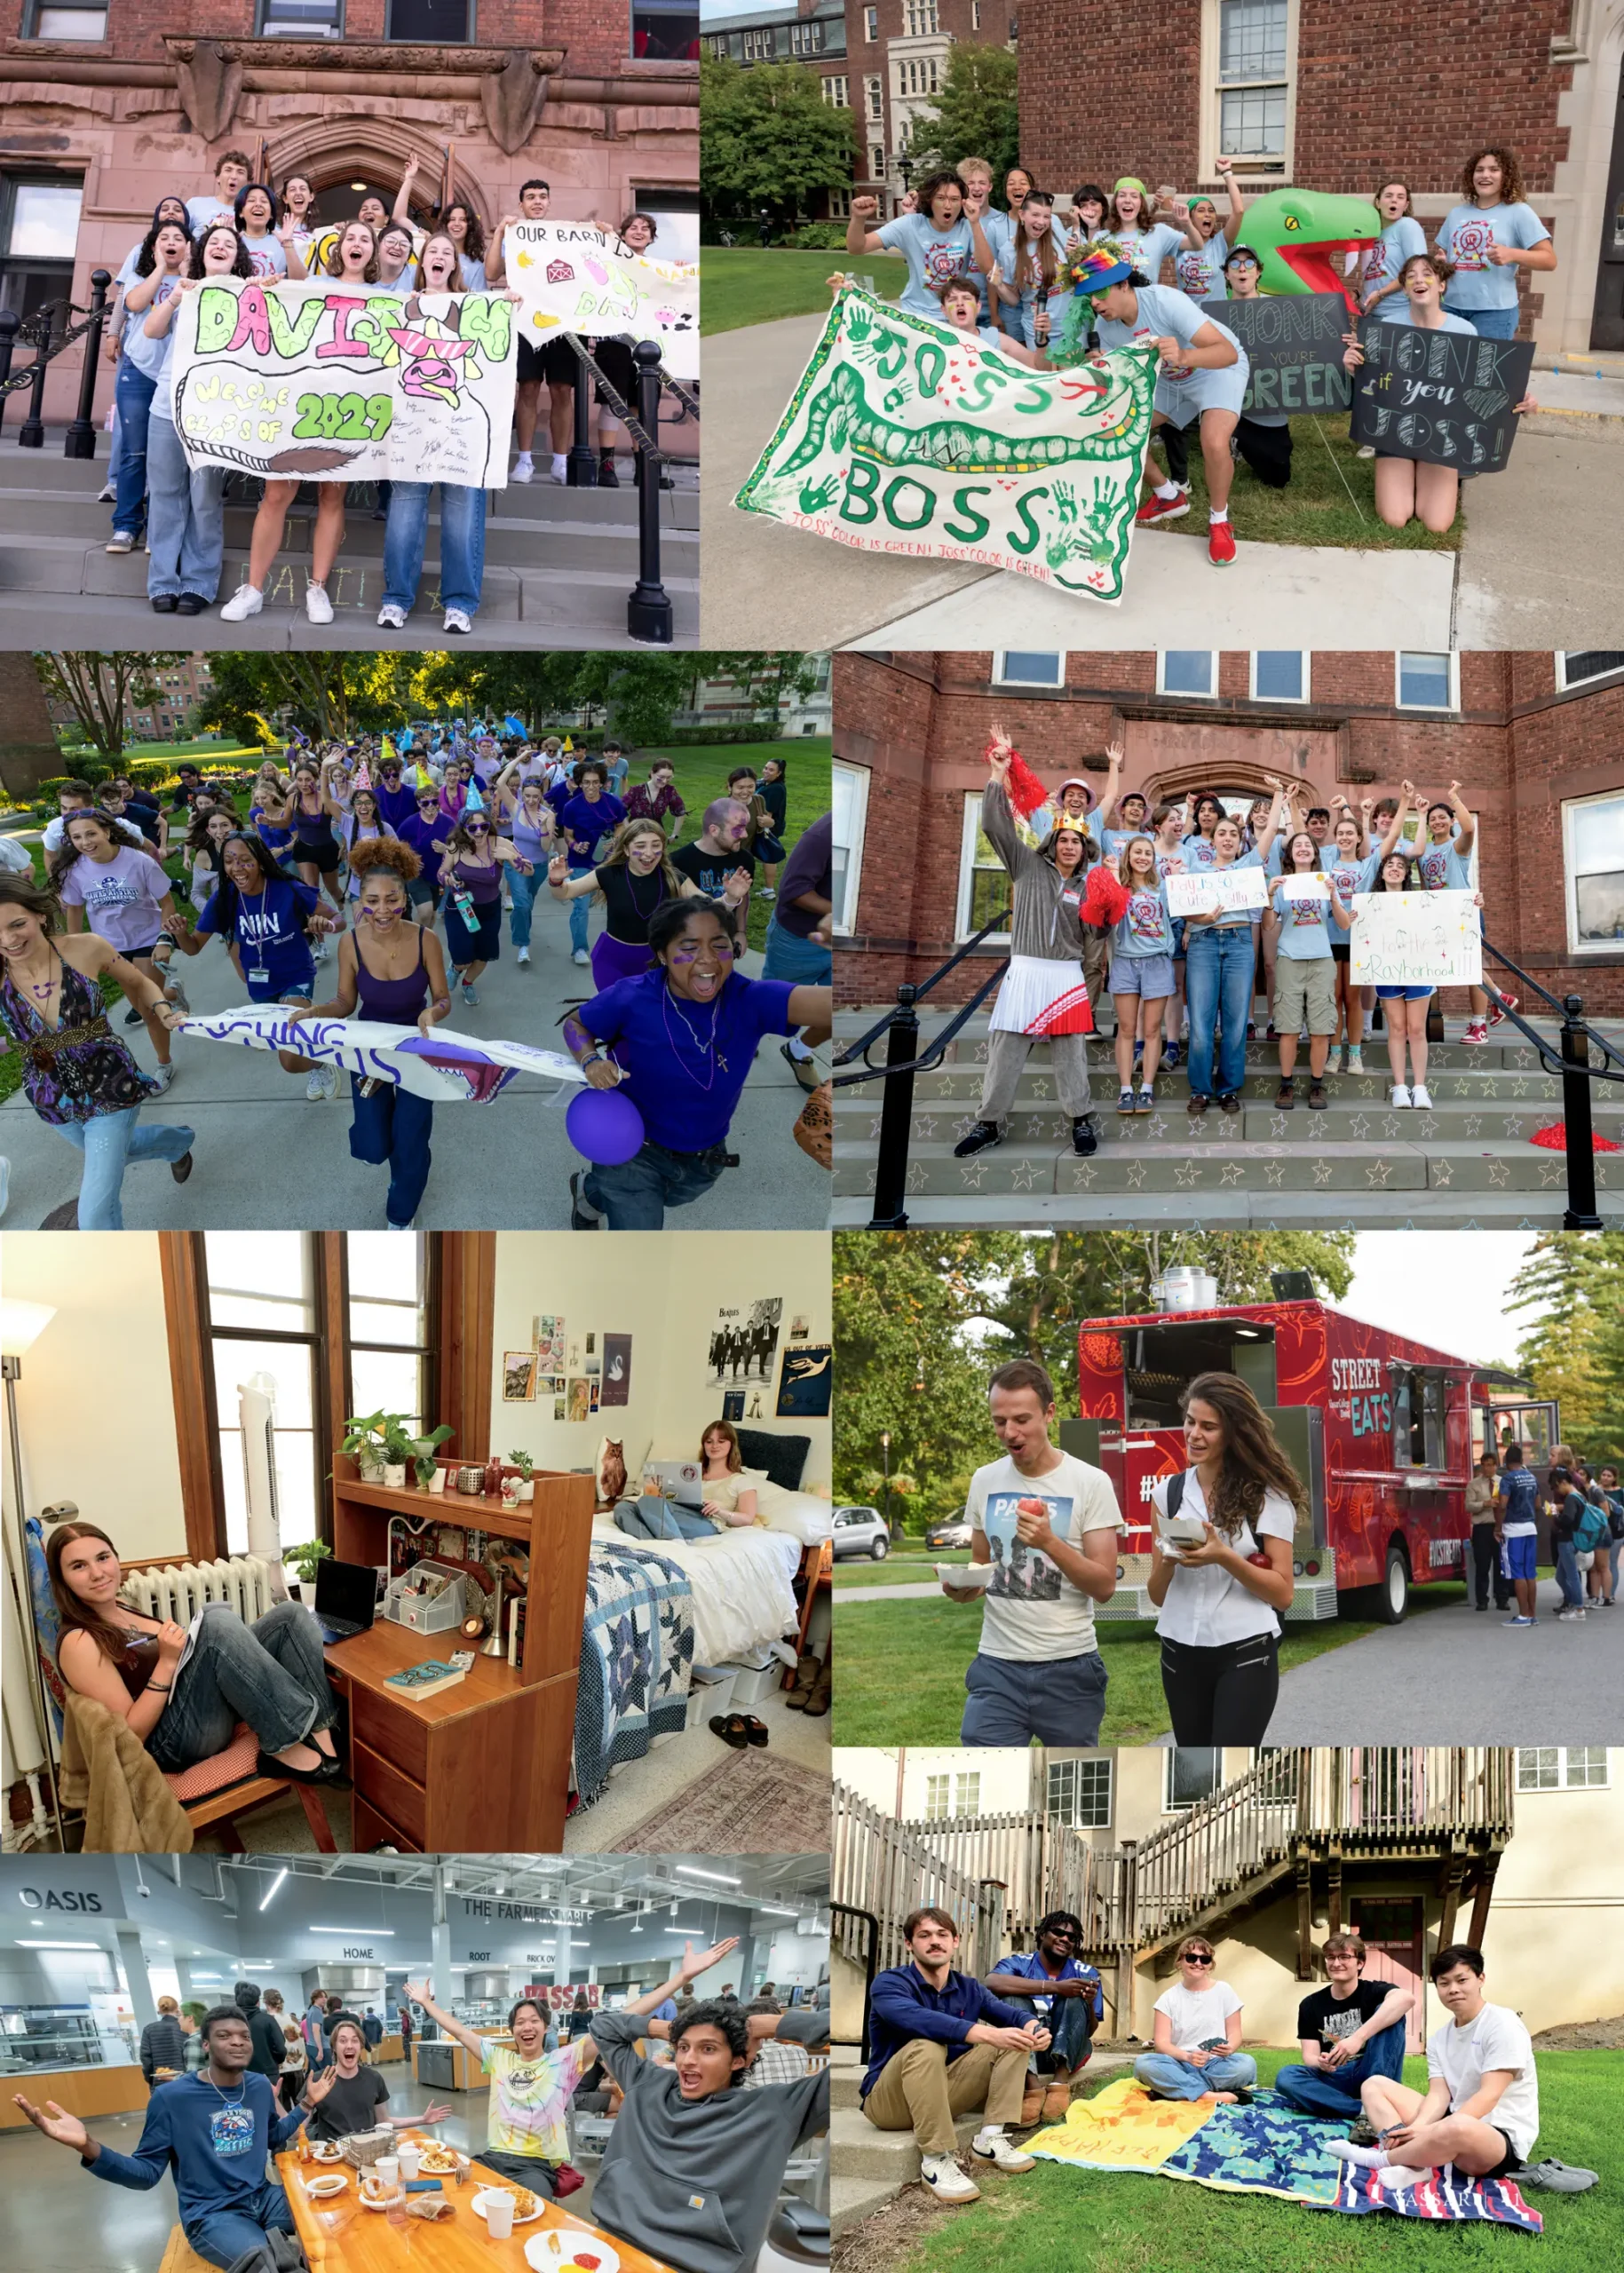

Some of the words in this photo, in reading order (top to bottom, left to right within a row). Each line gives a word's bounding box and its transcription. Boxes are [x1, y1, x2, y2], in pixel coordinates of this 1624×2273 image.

[516, 226, 548, 242] OUR
[557, 229, 606, 248] BARN
[612, 236, 634, 259] IS
[194, 286, 514, 362] DAVISN
[1229, 297, 1339, 346] HONK
[1248, 353, 1259, 365] F
[1271, 351, 1318, 365] YOU'RE
[1365, 327, 1517, 390] HONK
[1379, 372, 1393, 391] if
[1400, 378, 1458, 406] you
[186, 414, 252, 441] CLASS
[257, 420, 282, 443] OF
[292, 392, 392, 441] 2029
[839, 459, 1050, 555] BOSS
[832, 527, 865, 549] COLOR
[870, 540, 880, 550] IS
[885, 541, 932, 556] GREEN!
[970, 549, 1003, 566] COLOR
[1005, 557, 1013, 568] IS
[1332, 1358, 1381, 1391] STREET
[1351, 1392, 1391, 1437] EATS
[994, 1498, 1058, 1520] PAS
[19, 1888, 102, 1913] OASIS
[463, 1898, 492, 1917] THE
[343, 1947, 374, 1959] HOME
[469, 1952, 491, 1961] ROOT
[527, 1954, 545, 1963] BRICK
[1392, 2192, 1472, 2207] VASSAR
